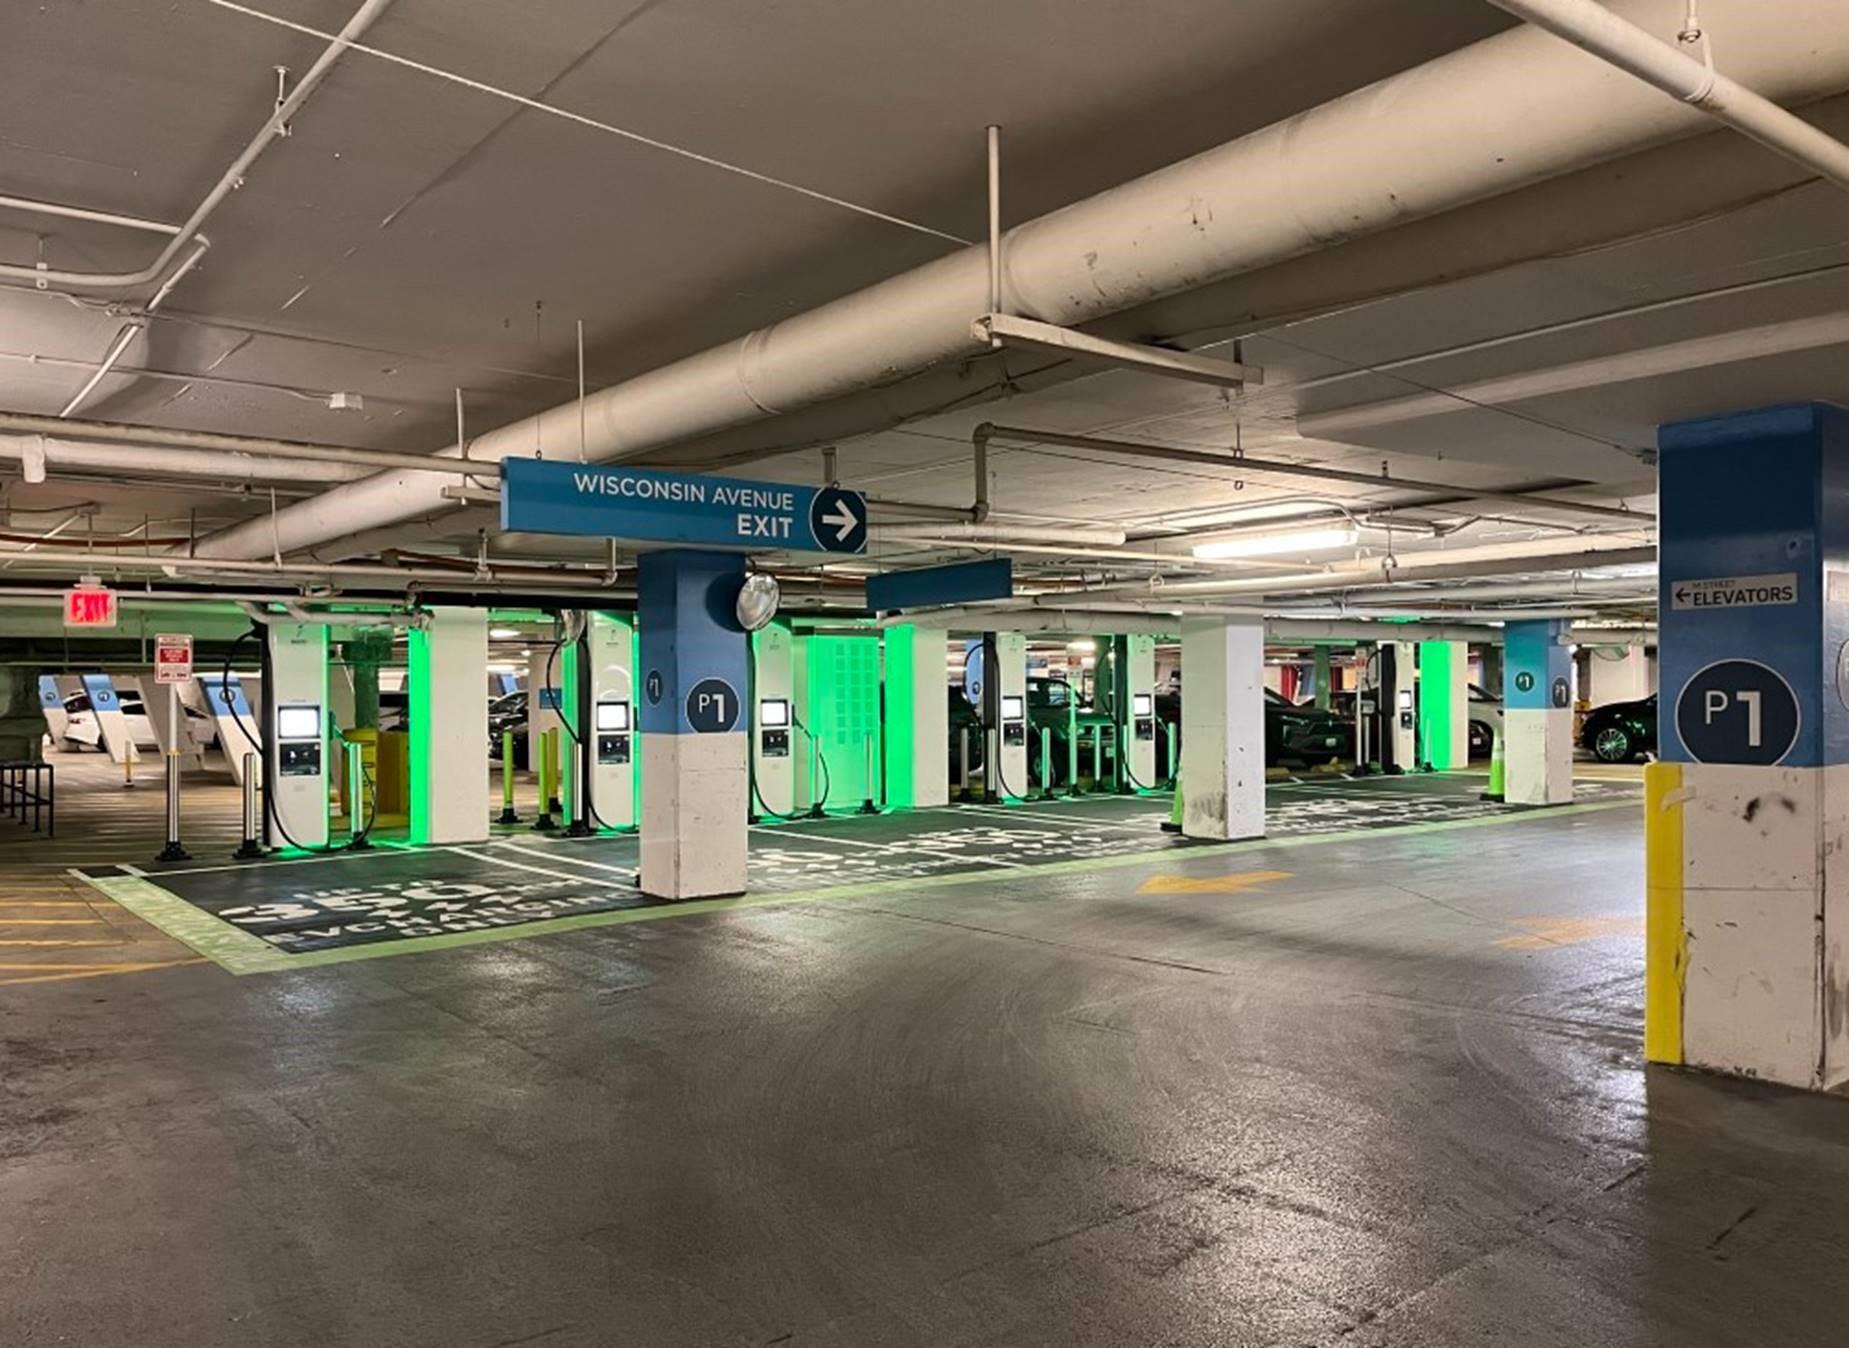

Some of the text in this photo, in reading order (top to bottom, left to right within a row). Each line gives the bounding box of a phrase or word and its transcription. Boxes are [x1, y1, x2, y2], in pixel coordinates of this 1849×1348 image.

[573, 472, 795, 511] WISCONSIN AVENUE
[737, 513, 793, 538] EXIT
[70, 592, 112, 623] EXIT
[1693, 586, 1793, 606] ELEVATORS
[699, 693, 725, 723] P1
[1704, 690, 1762, 747] P1
[218, 884, 498, 924] 350
